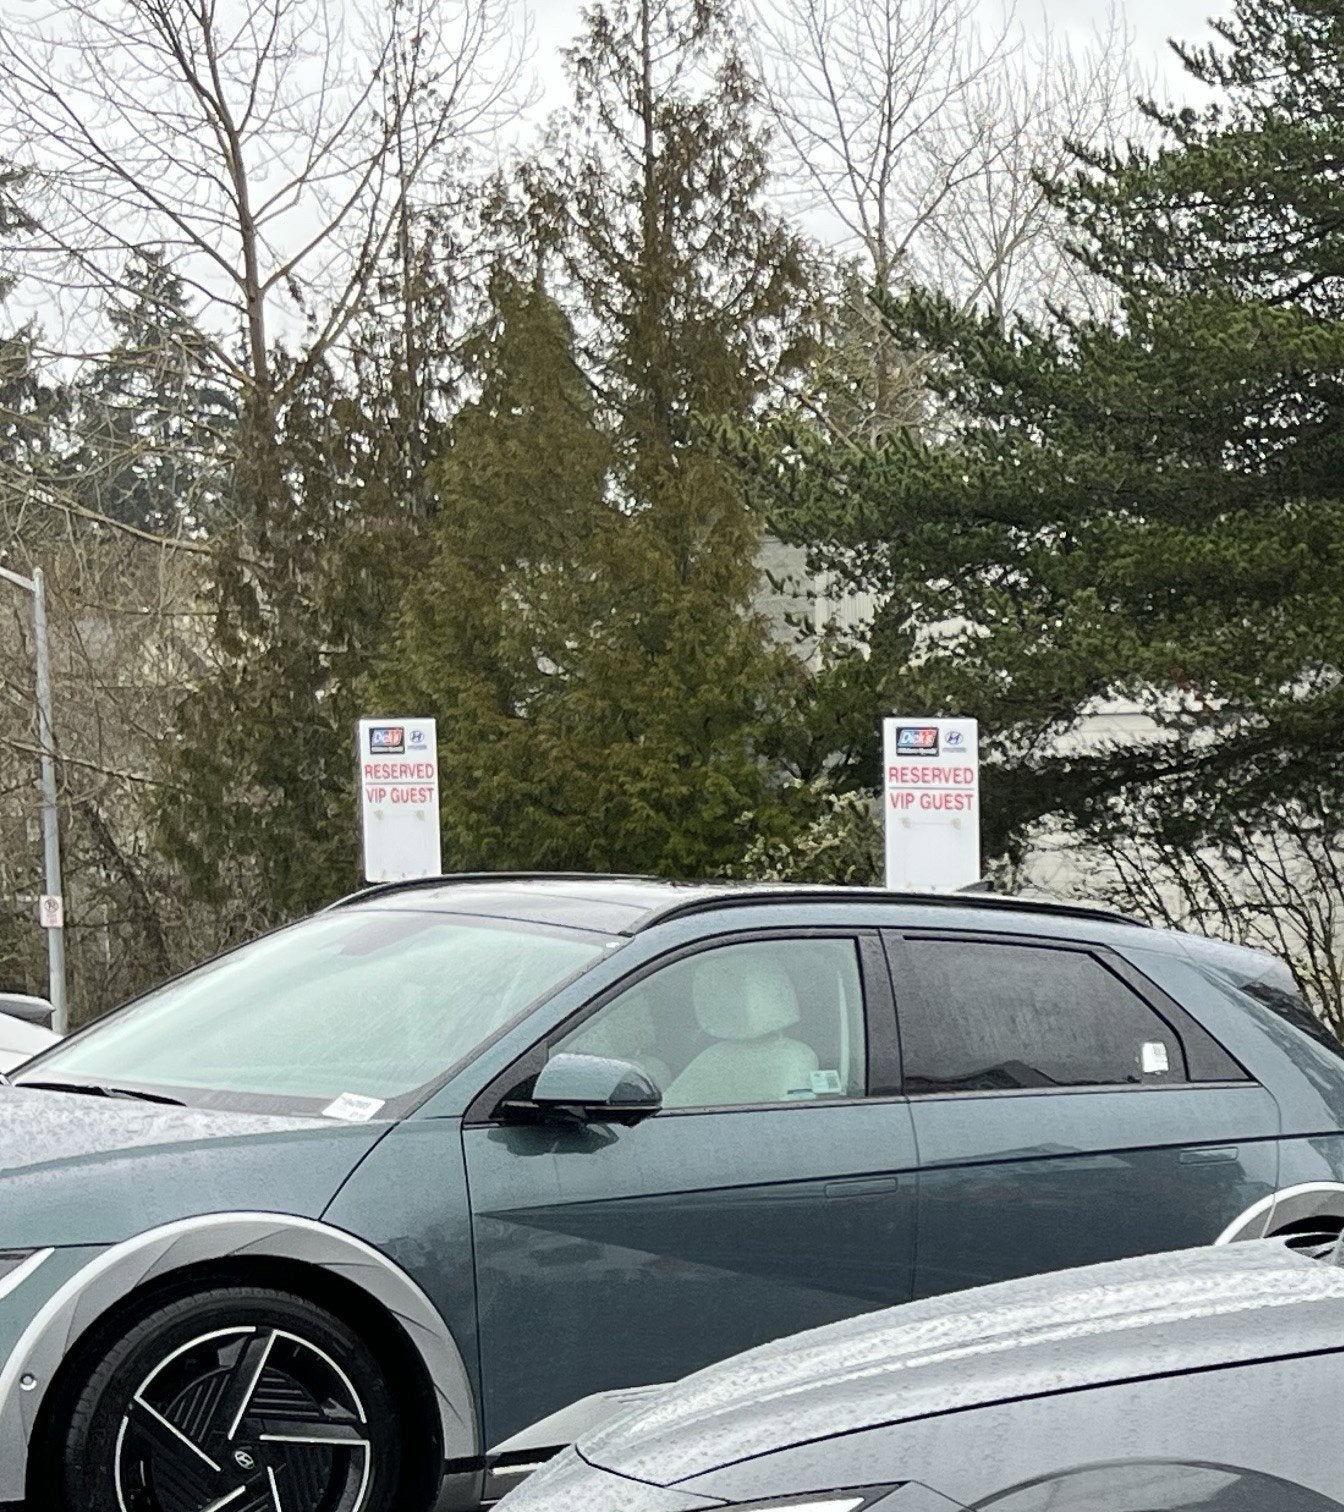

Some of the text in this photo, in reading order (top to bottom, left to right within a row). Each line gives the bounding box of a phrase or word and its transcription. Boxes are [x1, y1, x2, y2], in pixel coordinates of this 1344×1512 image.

[364, 763, 434, 780] RESERVED
[888, 766, 974, 784] RESERVED
[366, 787, 435, 804] VIP GUEST
[890, 792, 974, 811] VIP GUEST
